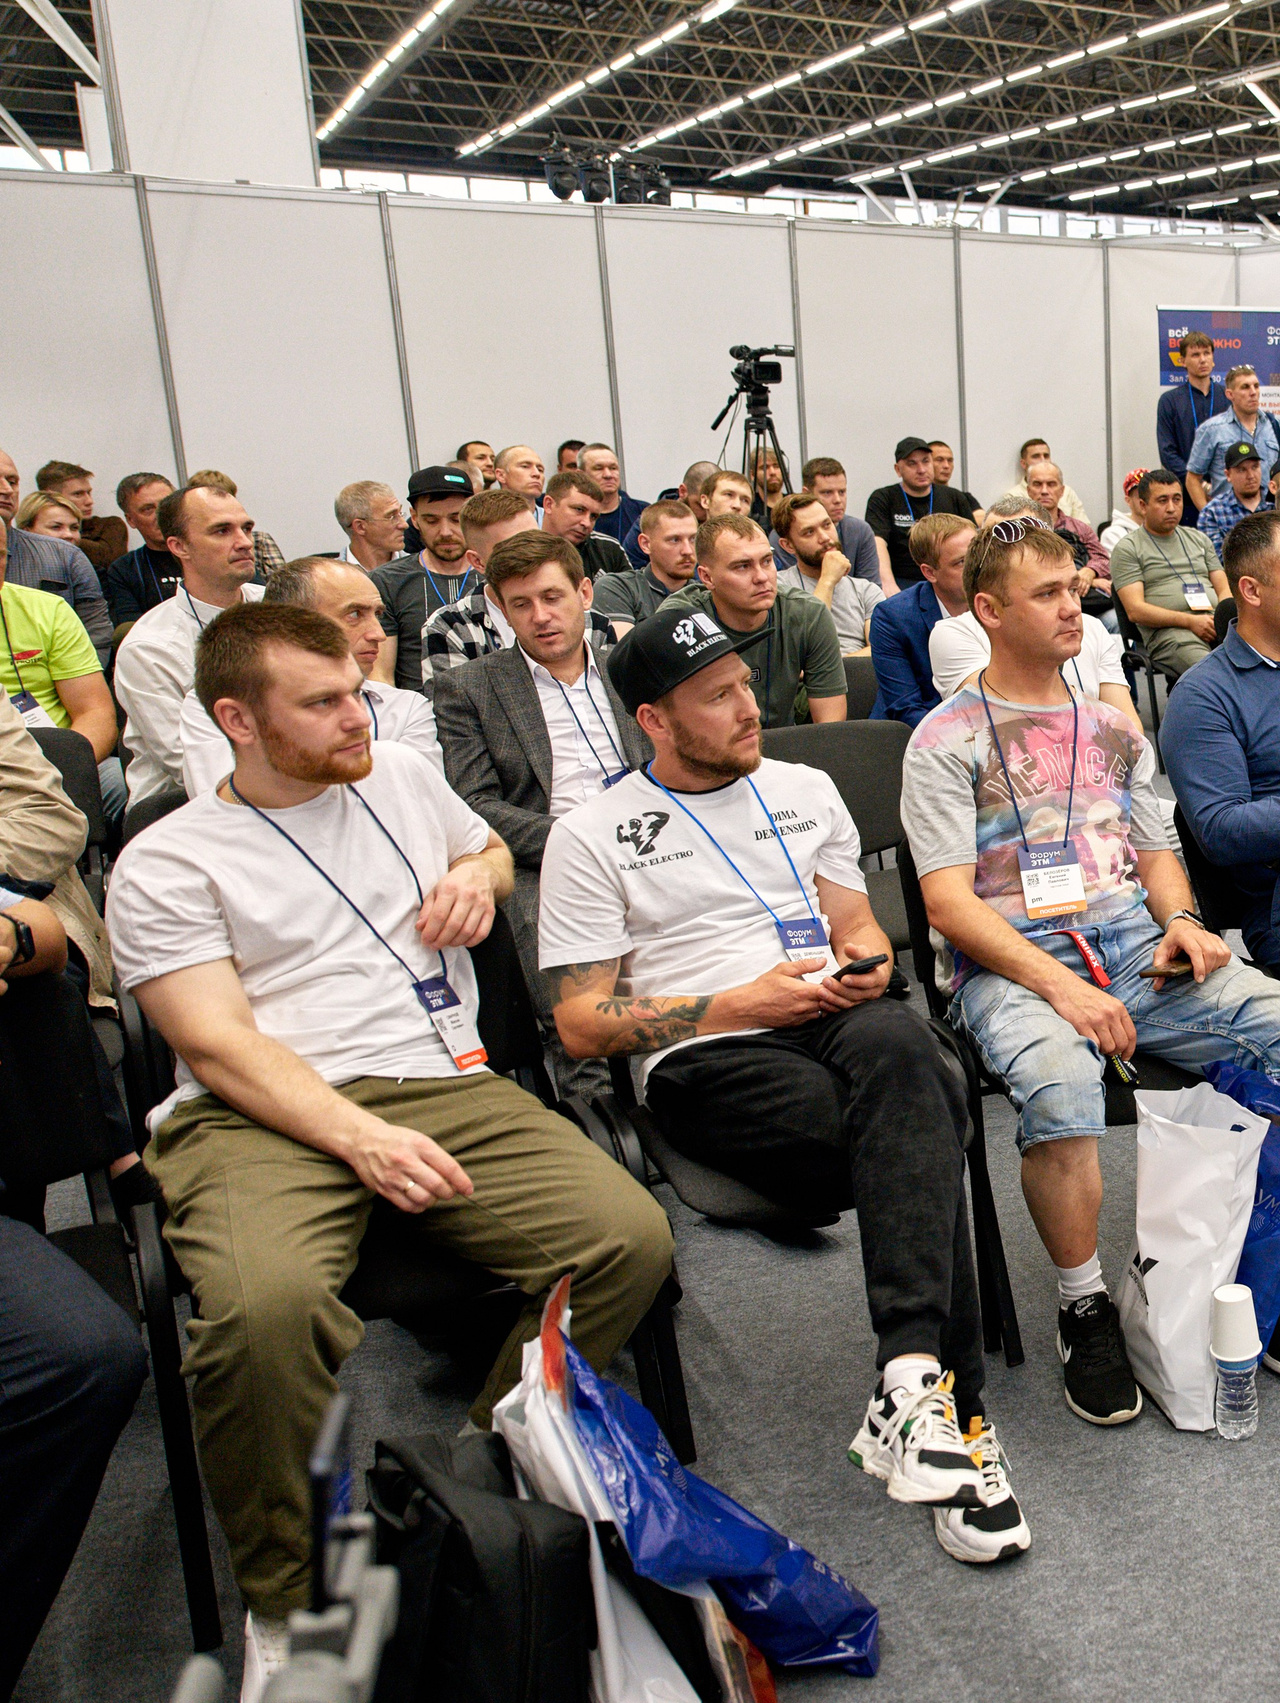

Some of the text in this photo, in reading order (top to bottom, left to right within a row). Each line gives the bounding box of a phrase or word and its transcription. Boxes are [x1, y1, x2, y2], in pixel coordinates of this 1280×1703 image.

[686, 639, 710, 658] BLACK
[983, 743, 1129, 811] VENICE
[769, 809, 798, 822] DIMA
[649, 849, 694, 867] ELECTRO
[1029, 851, 1061, 859] Форум
[1031, 858, 1050, 867] ЭТМ
[1039, 904, 1078, 914] ПОСЕТИТЕЛЬ
[786, 929, 812, 938] Форум
[789, 937, 806, 946] ЭТМ
[1076, 934, 1100, 968] KNIPEX
